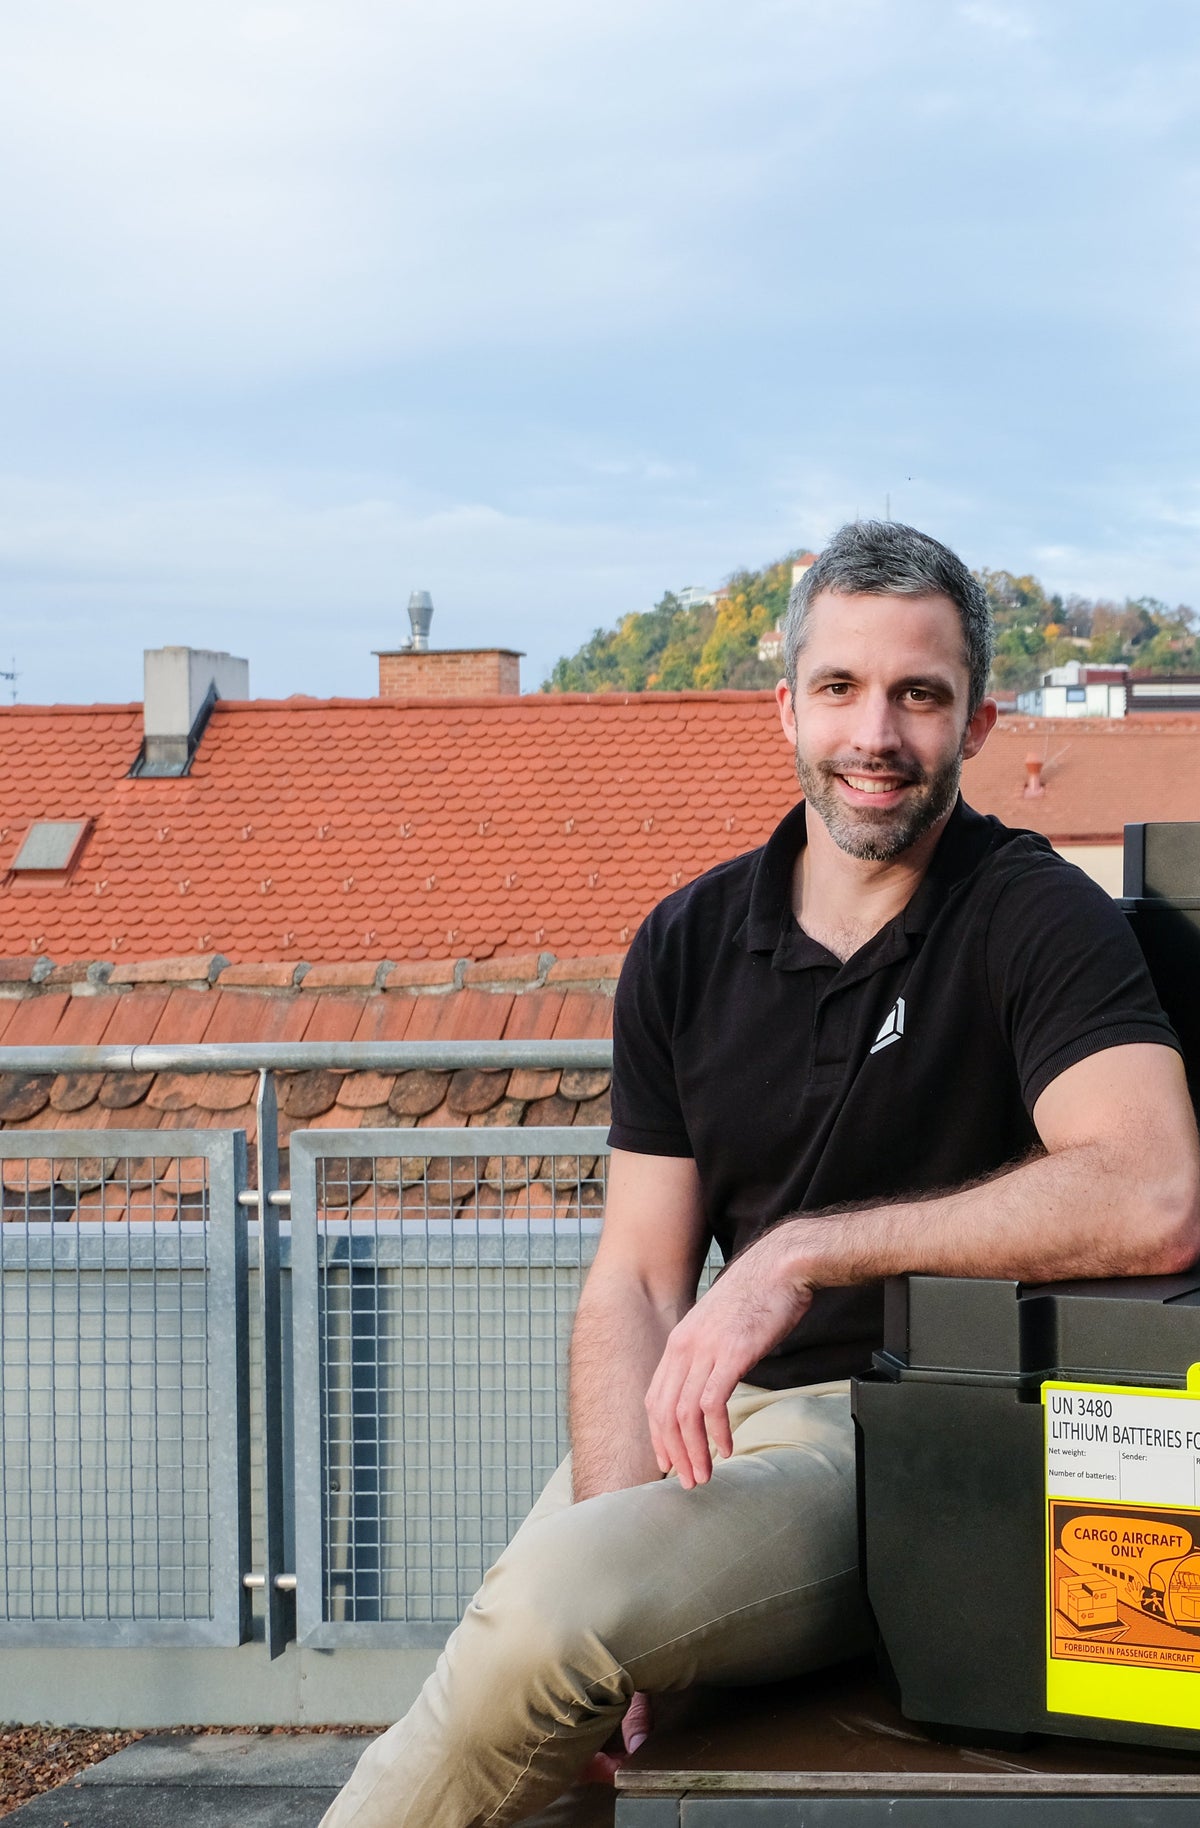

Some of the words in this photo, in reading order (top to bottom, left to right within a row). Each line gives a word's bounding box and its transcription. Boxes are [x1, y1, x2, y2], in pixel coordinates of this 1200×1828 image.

[1052, 1396, 1073, 1415] UN
[1077, 1398, 1113, 1418] 3480
[1052, 1421, 1108, 1443] LITHIUM
[1112, 1425, 1182, 1449] BATTERIES
[1048, 1447, 1060, 1455] Net
[1062, 1449, 1087, 1457] weight:
[1121, 1452, 1148, 1462] Sender:
[1048, 1469, 1076, 1478] Number
[1077, 1471, 1084, 1479] of
[1085, 1472, 1117, 1481] batteries:
[1074, 1528, 1118, 1542] CARGO
[1122, 1531, 1183, 1547] AIRCRAFT
[1111, 1545, 1144, 1558] ONLY
[1064, 1642, 1105, 1655] FORBIDDEN
[1107, 1647, 1115, 1655] IN
[1116, 1648, 1158, 1659] PASSENGER
[1160, 1651, 1195, 1663] AIRCRAFT
